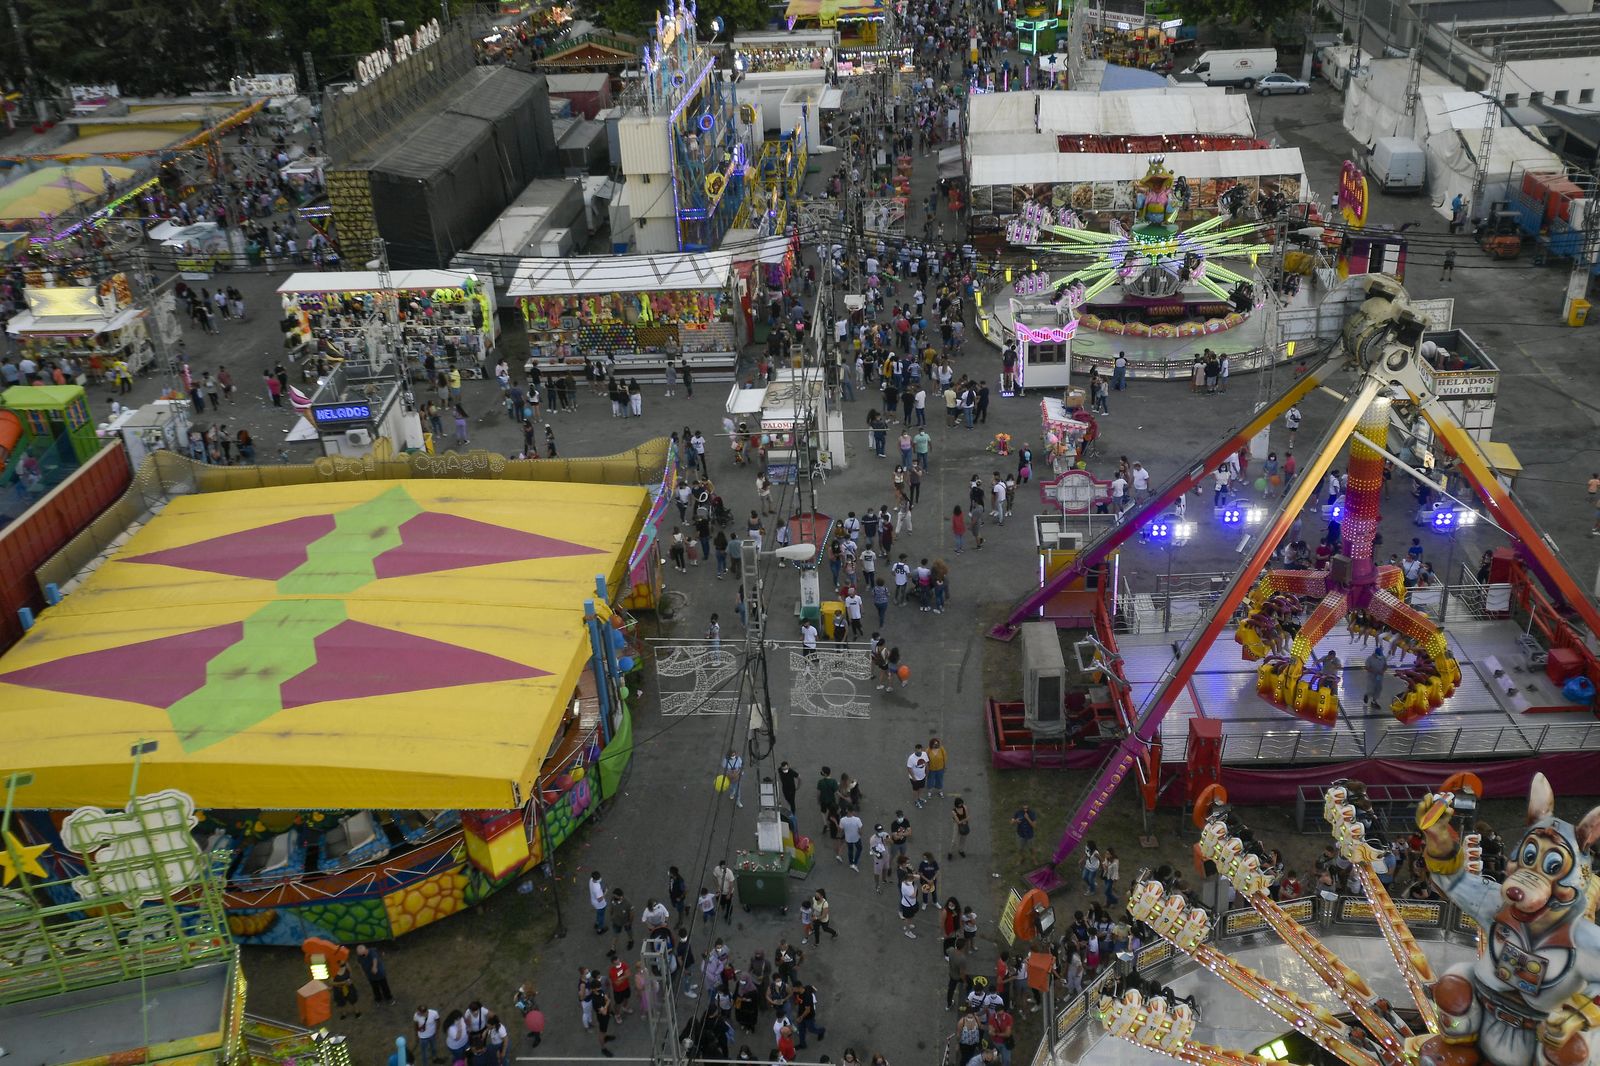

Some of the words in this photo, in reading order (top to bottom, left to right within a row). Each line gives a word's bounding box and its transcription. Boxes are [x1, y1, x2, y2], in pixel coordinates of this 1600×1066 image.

[1437, 377, 1494, 386] HELADOS
[1443, 386, 1486, 394] VIOLETA
[315, 406, 370, 420] HELADOS
